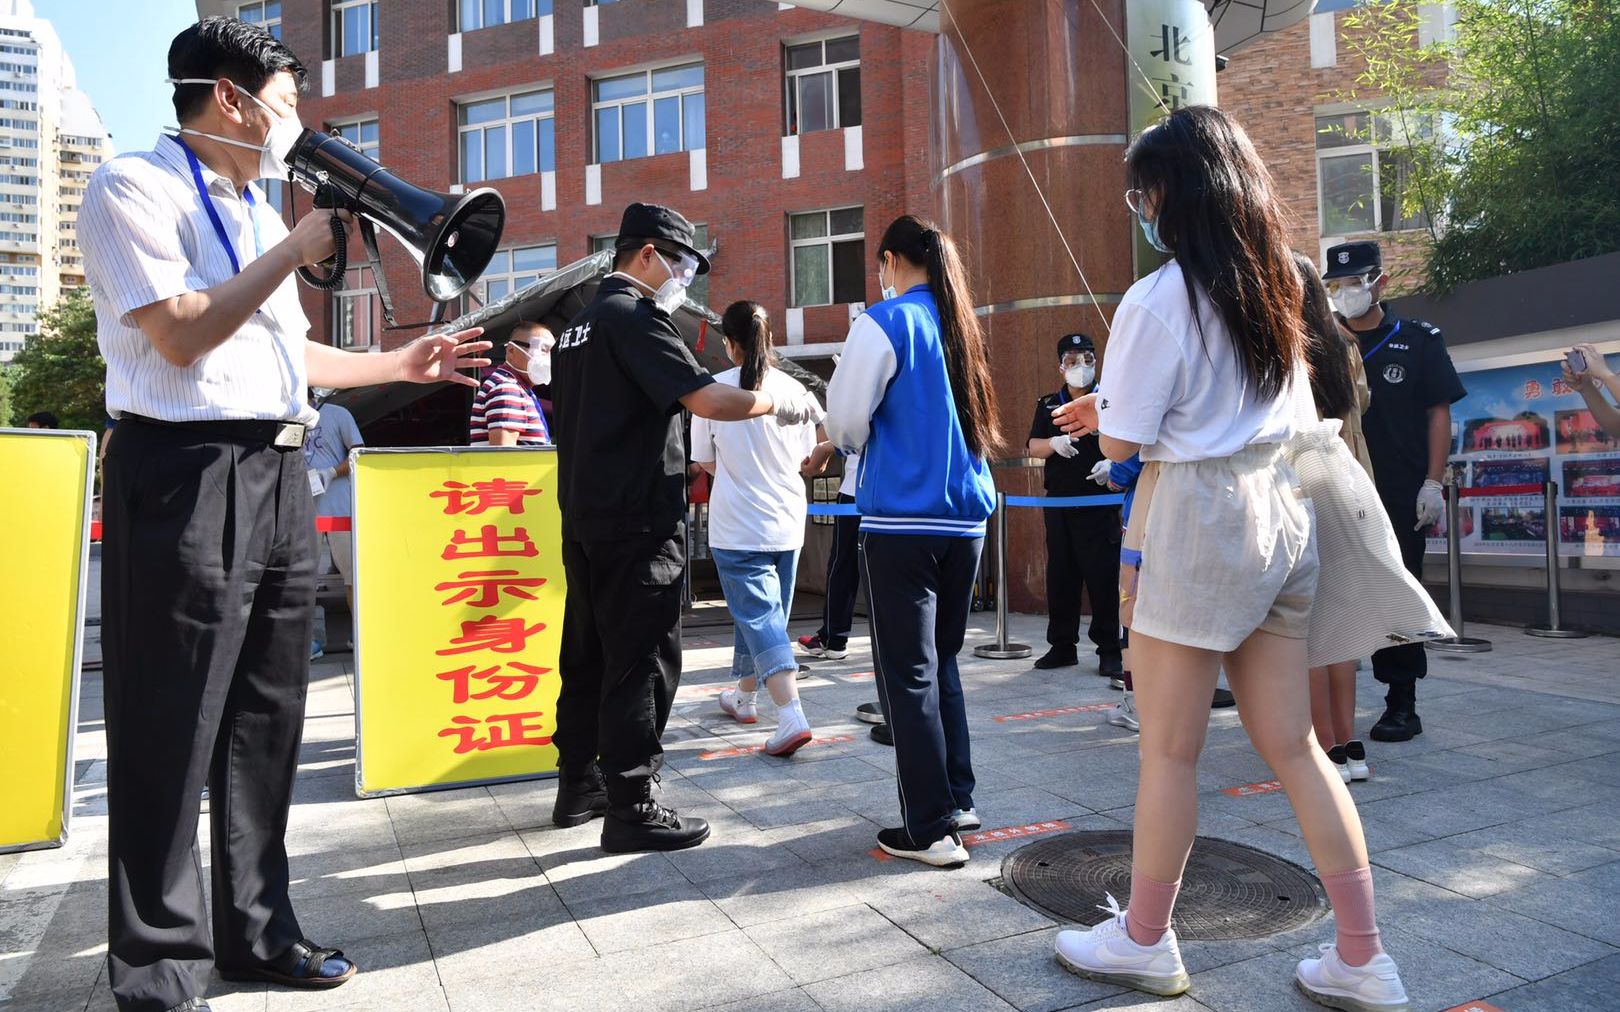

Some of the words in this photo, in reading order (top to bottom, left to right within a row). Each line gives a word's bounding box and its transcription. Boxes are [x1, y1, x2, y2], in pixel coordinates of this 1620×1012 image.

[428, 477, 554, 755] 请出示身份证
